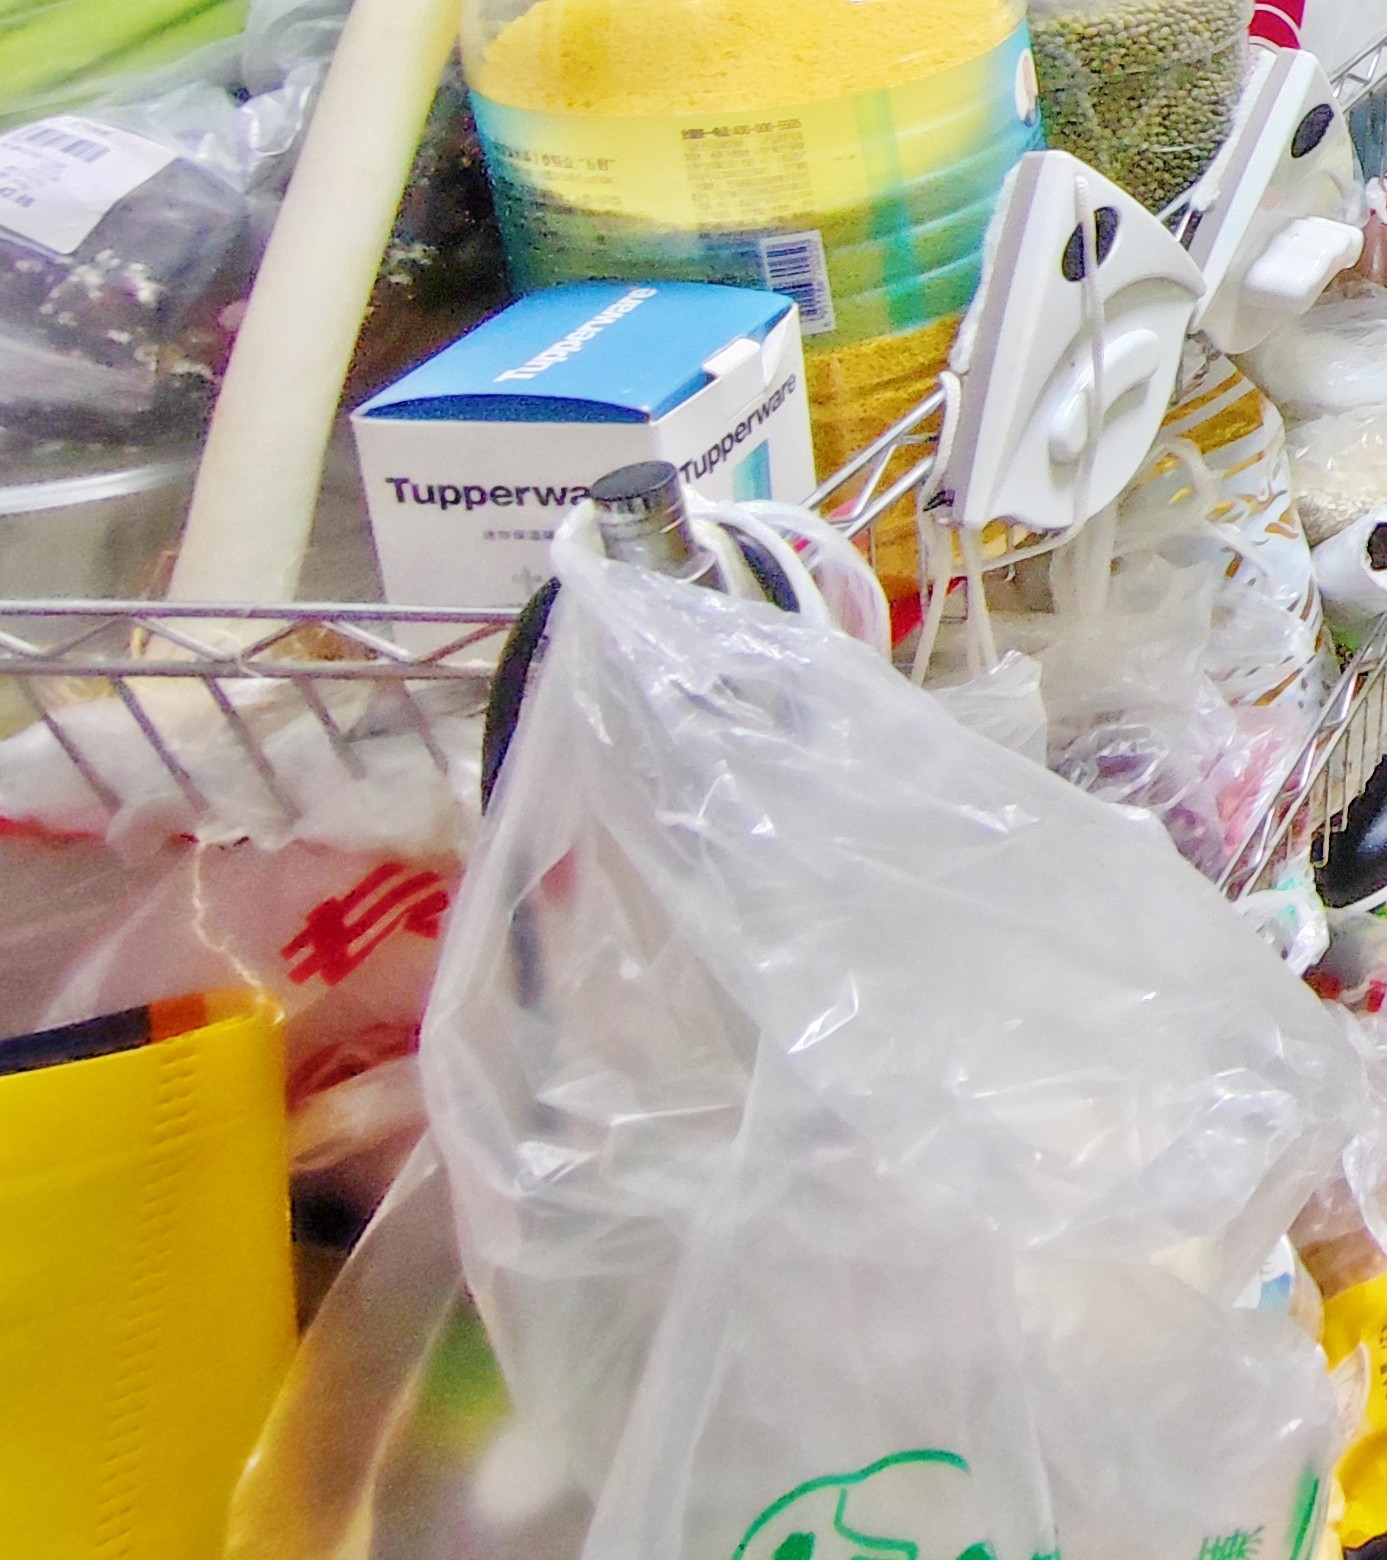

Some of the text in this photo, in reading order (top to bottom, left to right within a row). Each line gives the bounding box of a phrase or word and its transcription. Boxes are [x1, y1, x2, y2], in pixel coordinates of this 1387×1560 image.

[494, 287, 658, 383] Tupperware
[679, 372, 798, 485] Tupperware
[386, 476, 592, 511] Tupperwa
